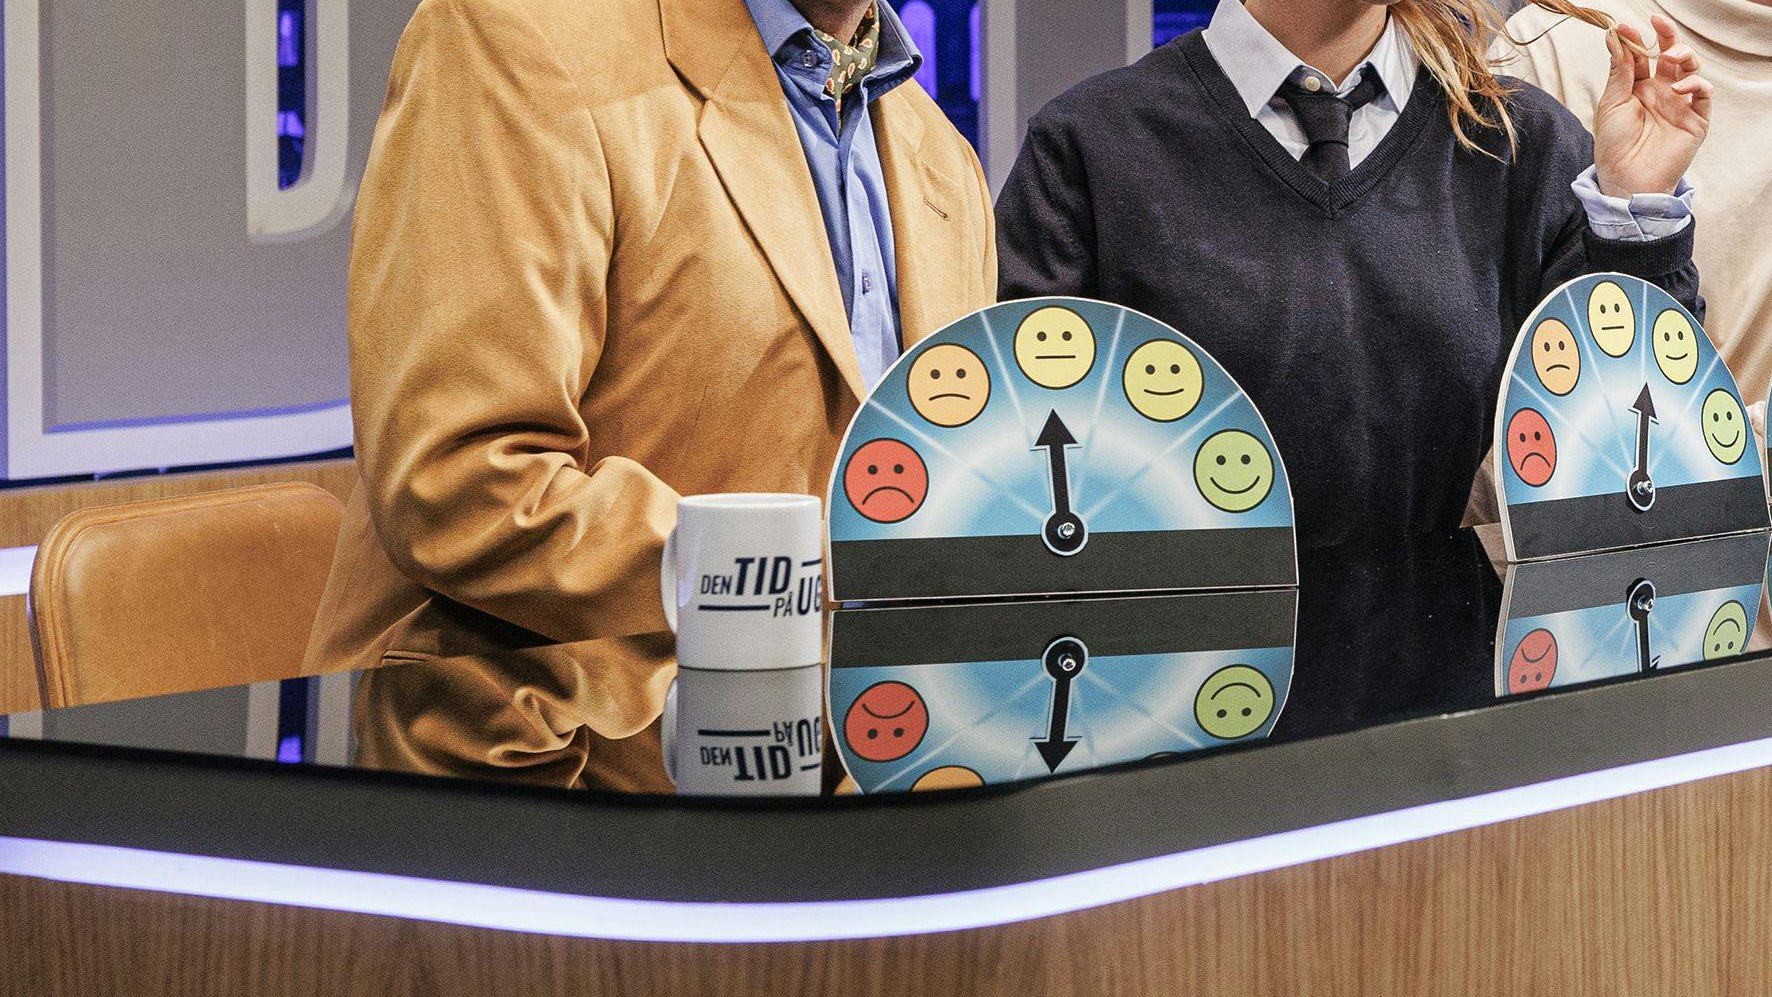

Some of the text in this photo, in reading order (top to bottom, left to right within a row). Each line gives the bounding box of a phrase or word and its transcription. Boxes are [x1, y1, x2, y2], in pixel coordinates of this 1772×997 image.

[700, 556, 792, 596] DEN TID
[773, 591, 793, 618] PÅ
